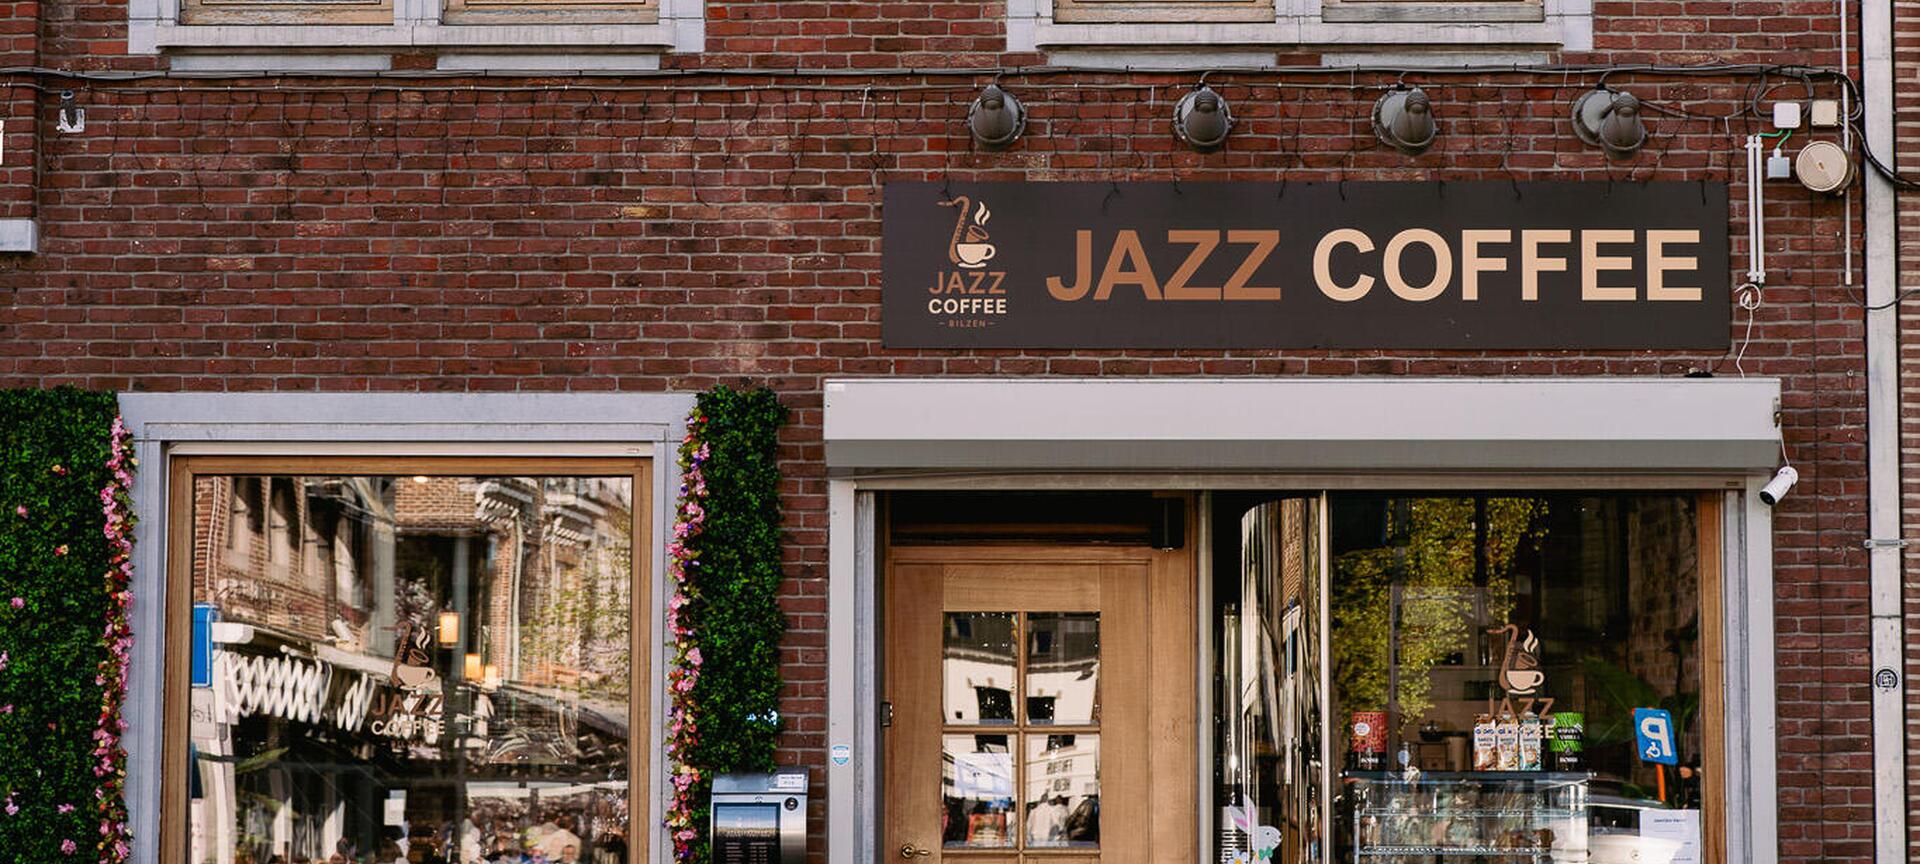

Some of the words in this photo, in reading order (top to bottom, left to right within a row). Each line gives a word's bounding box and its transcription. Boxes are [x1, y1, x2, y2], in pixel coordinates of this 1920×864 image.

[1046, 229, 1281, 301] JAZZ
[1313, 228, 1702, 301] COFFEE
[928, 271, 1007, 294] JAZZ
[928, 298, 1007, 314] COFFEE
[948, 319, 986, 328] BILZEN
[371, 693, 445, 716] JAZZ
[1485, 697, 1555, 721] JAZZ
